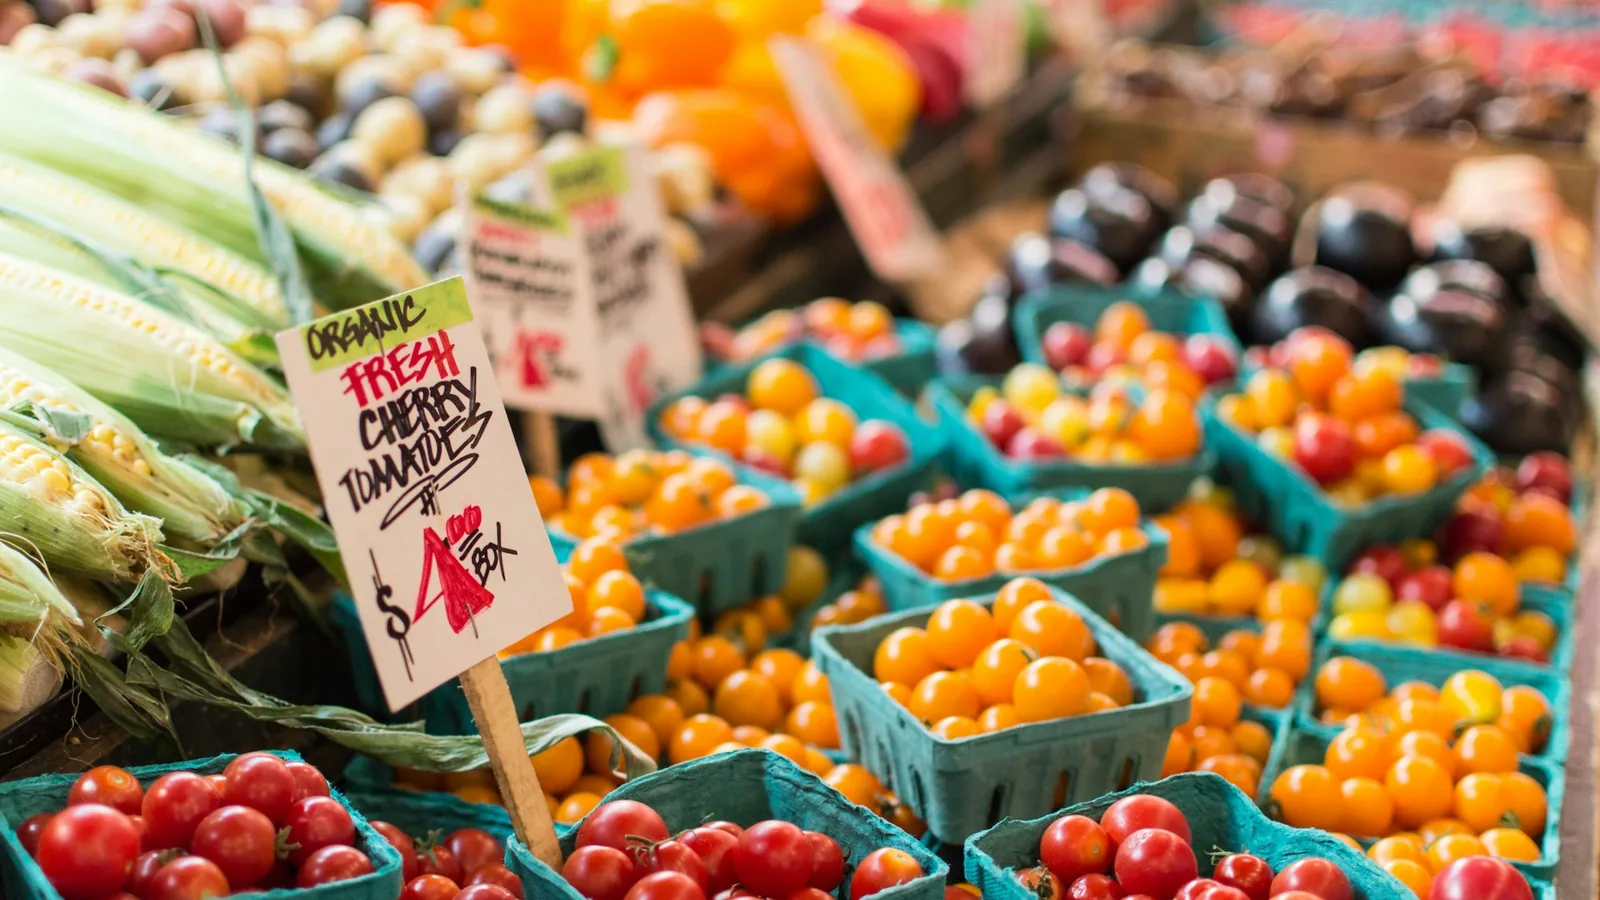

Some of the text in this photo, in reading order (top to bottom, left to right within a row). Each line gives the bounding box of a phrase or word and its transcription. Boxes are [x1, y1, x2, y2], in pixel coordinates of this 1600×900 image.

[307, 295, 426, 361] ORGANIC
[340, 329, 461, 407] FRESH
[358, 366, 481, 451] CHERRY
[338, 402, 493, 513] TOMATOES
[471, 521, 518, 587] BOX
